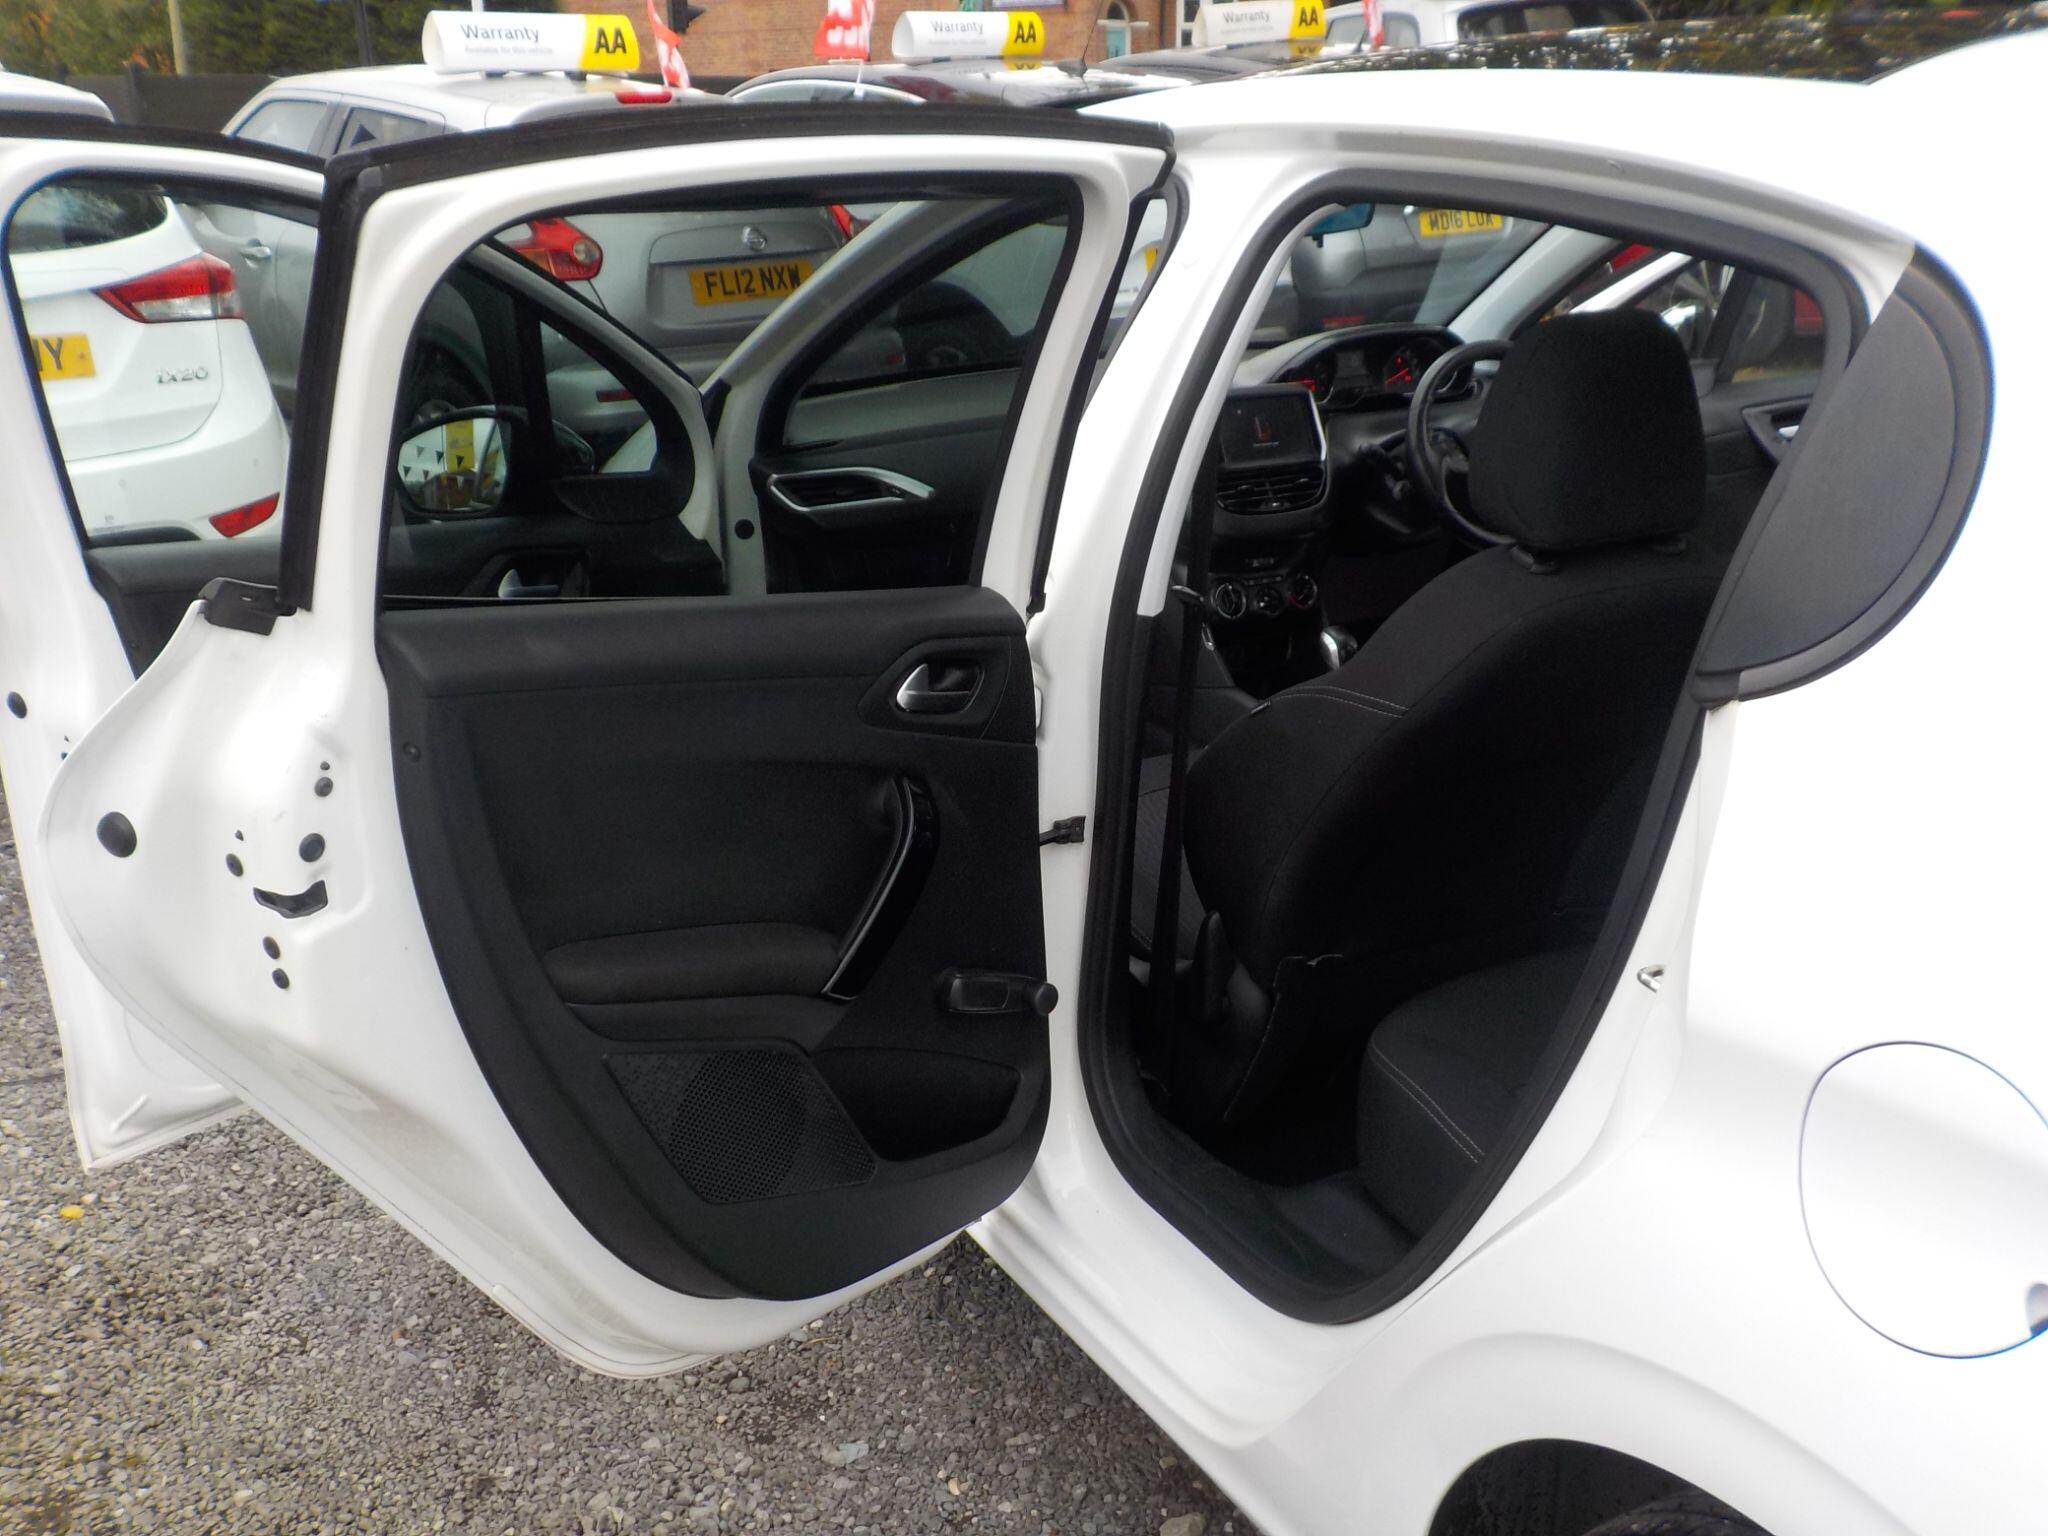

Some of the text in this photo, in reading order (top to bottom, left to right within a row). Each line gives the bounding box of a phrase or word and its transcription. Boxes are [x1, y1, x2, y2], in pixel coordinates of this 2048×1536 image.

[1222, 9, 1270, 23] Warranty
[1298, 6, 1318, 26] AA
[460, 24, 540, 43] Warranty
[931, 20, 983, 35] Warranty
[1014, 20, 1037, 44] AA
[594, 27, 628, 54] AA
[703, 264, 801, 298] FL12 NXW
